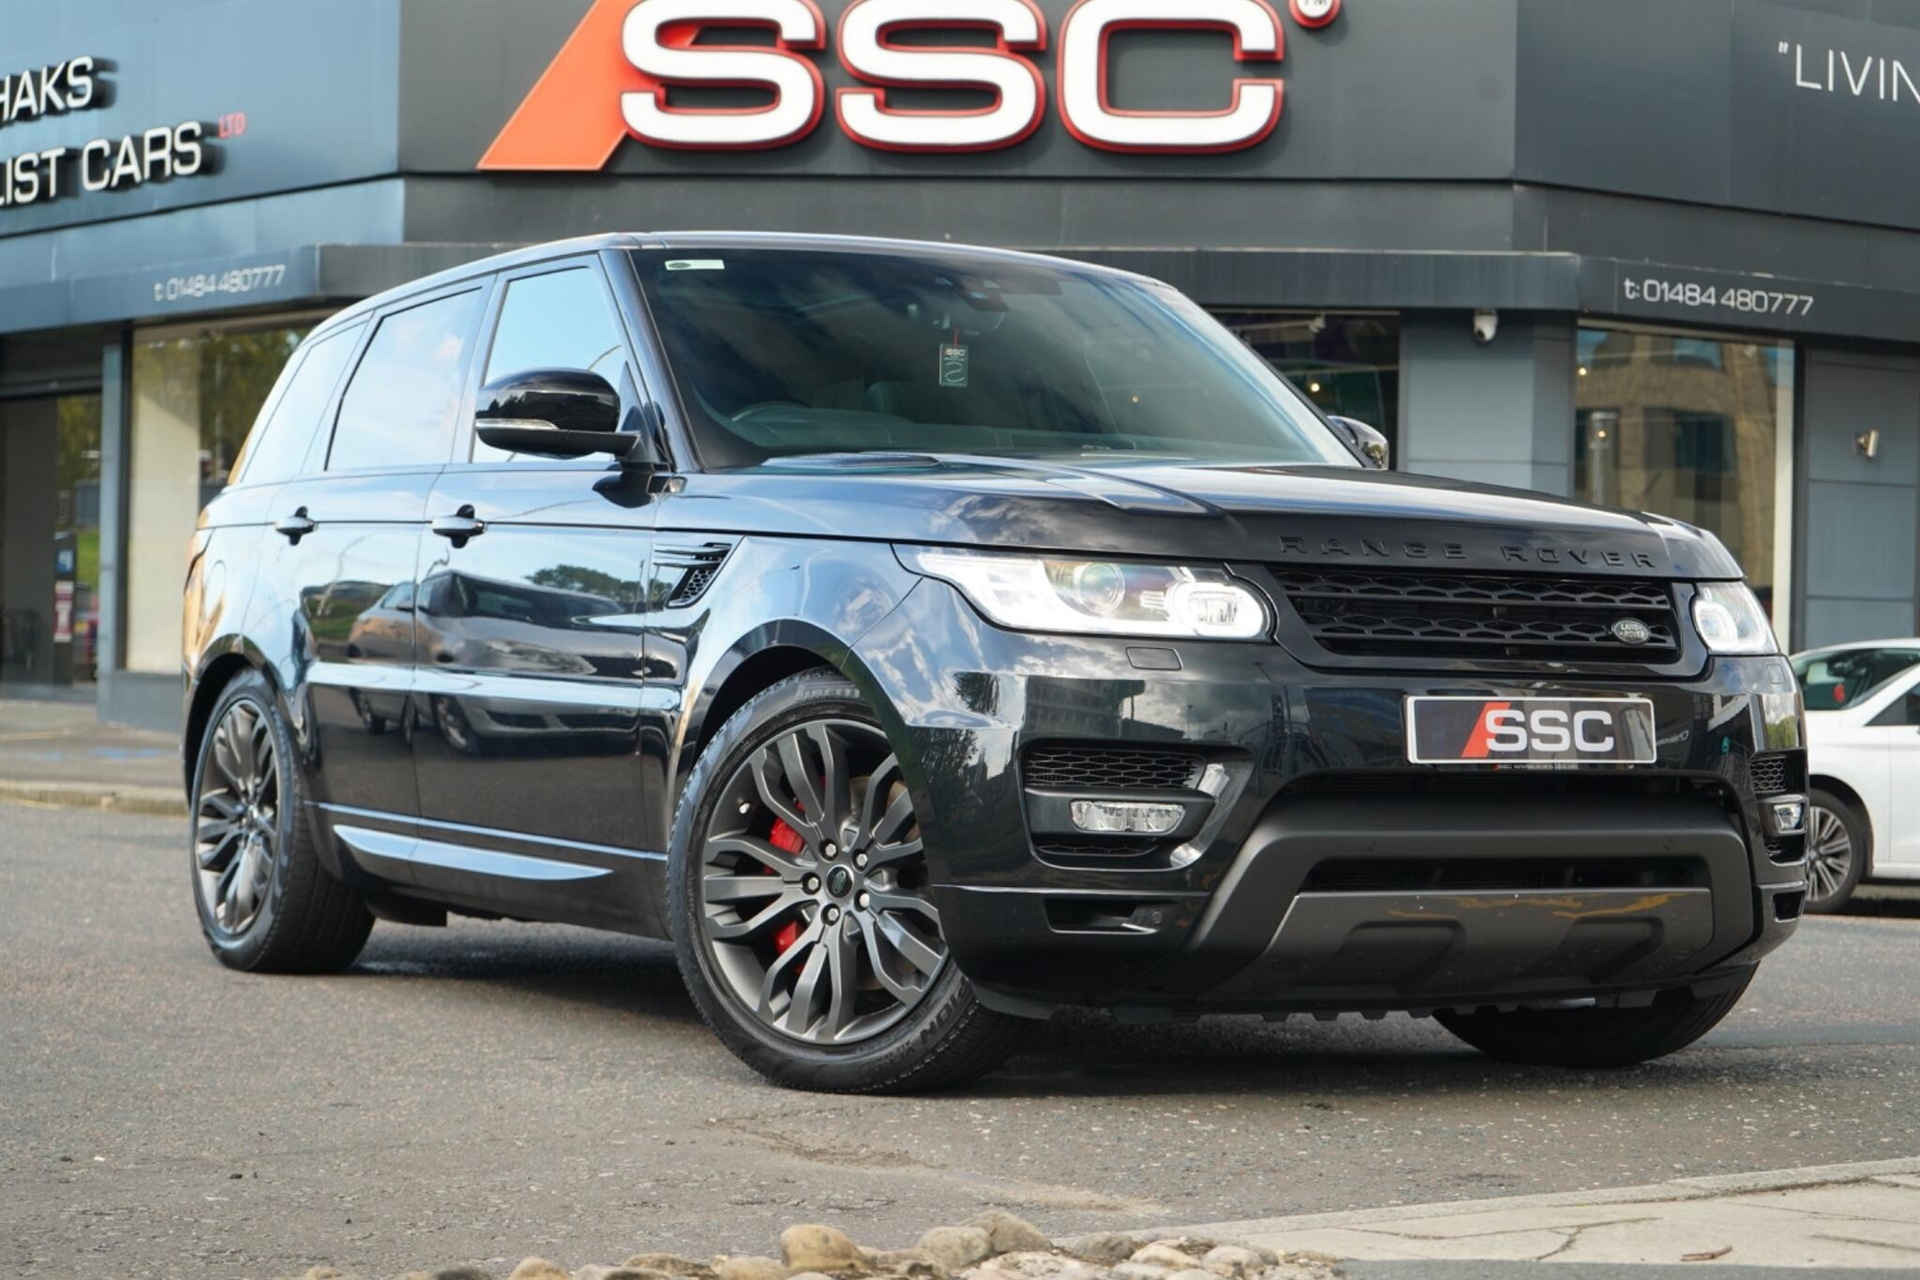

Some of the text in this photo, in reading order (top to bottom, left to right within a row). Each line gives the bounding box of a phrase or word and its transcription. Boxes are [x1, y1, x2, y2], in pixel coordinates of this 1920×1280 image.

[620, 0, 1284, 153] SSC
[0, 112, 247, 206] IST CARS LTD
[217, 264, 286, 293] 480777
[1720, 288, 1815, 317] 480777
[1279, 536, 1656, 568] RANGE ROVER
[1485, 709, 1615, 752] SSC
